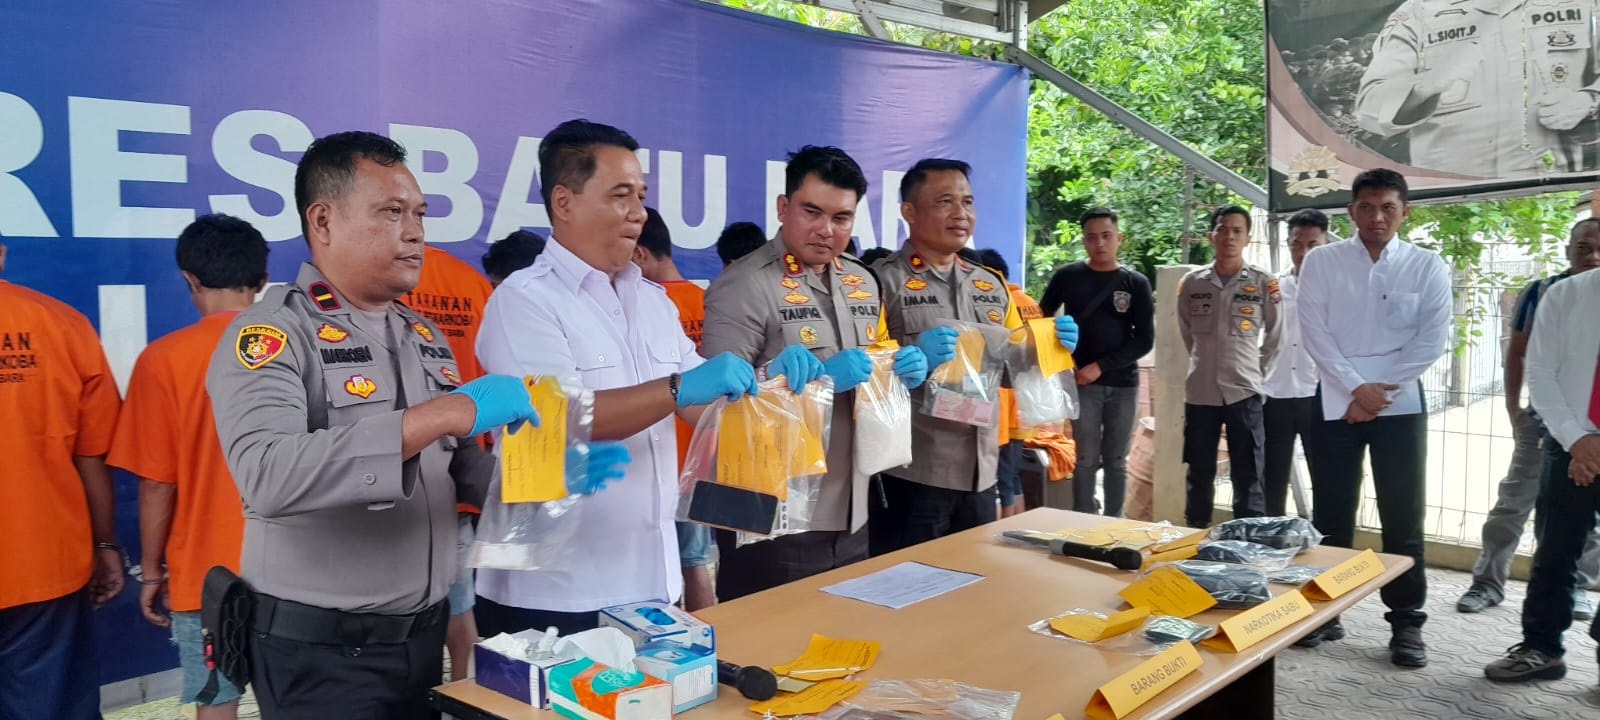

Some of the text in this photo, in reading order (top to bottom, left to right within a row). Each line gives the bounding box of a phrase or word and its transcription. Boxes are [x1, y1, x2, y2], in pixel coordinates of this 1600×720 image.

[1531, 8, 1582, 25] POLRI
[1428, 25, 1477, 44] L.SIGIT.P
[904, 295, 939, 306] IMAM
[972, 294, 1002, 304] POLRI
[780, 307, 822, 321] TAUFIQ
[1242, 610, 1283, 636] NARKOTIKA
[1130, 656, 1188, 695] BARANG BUKTI
